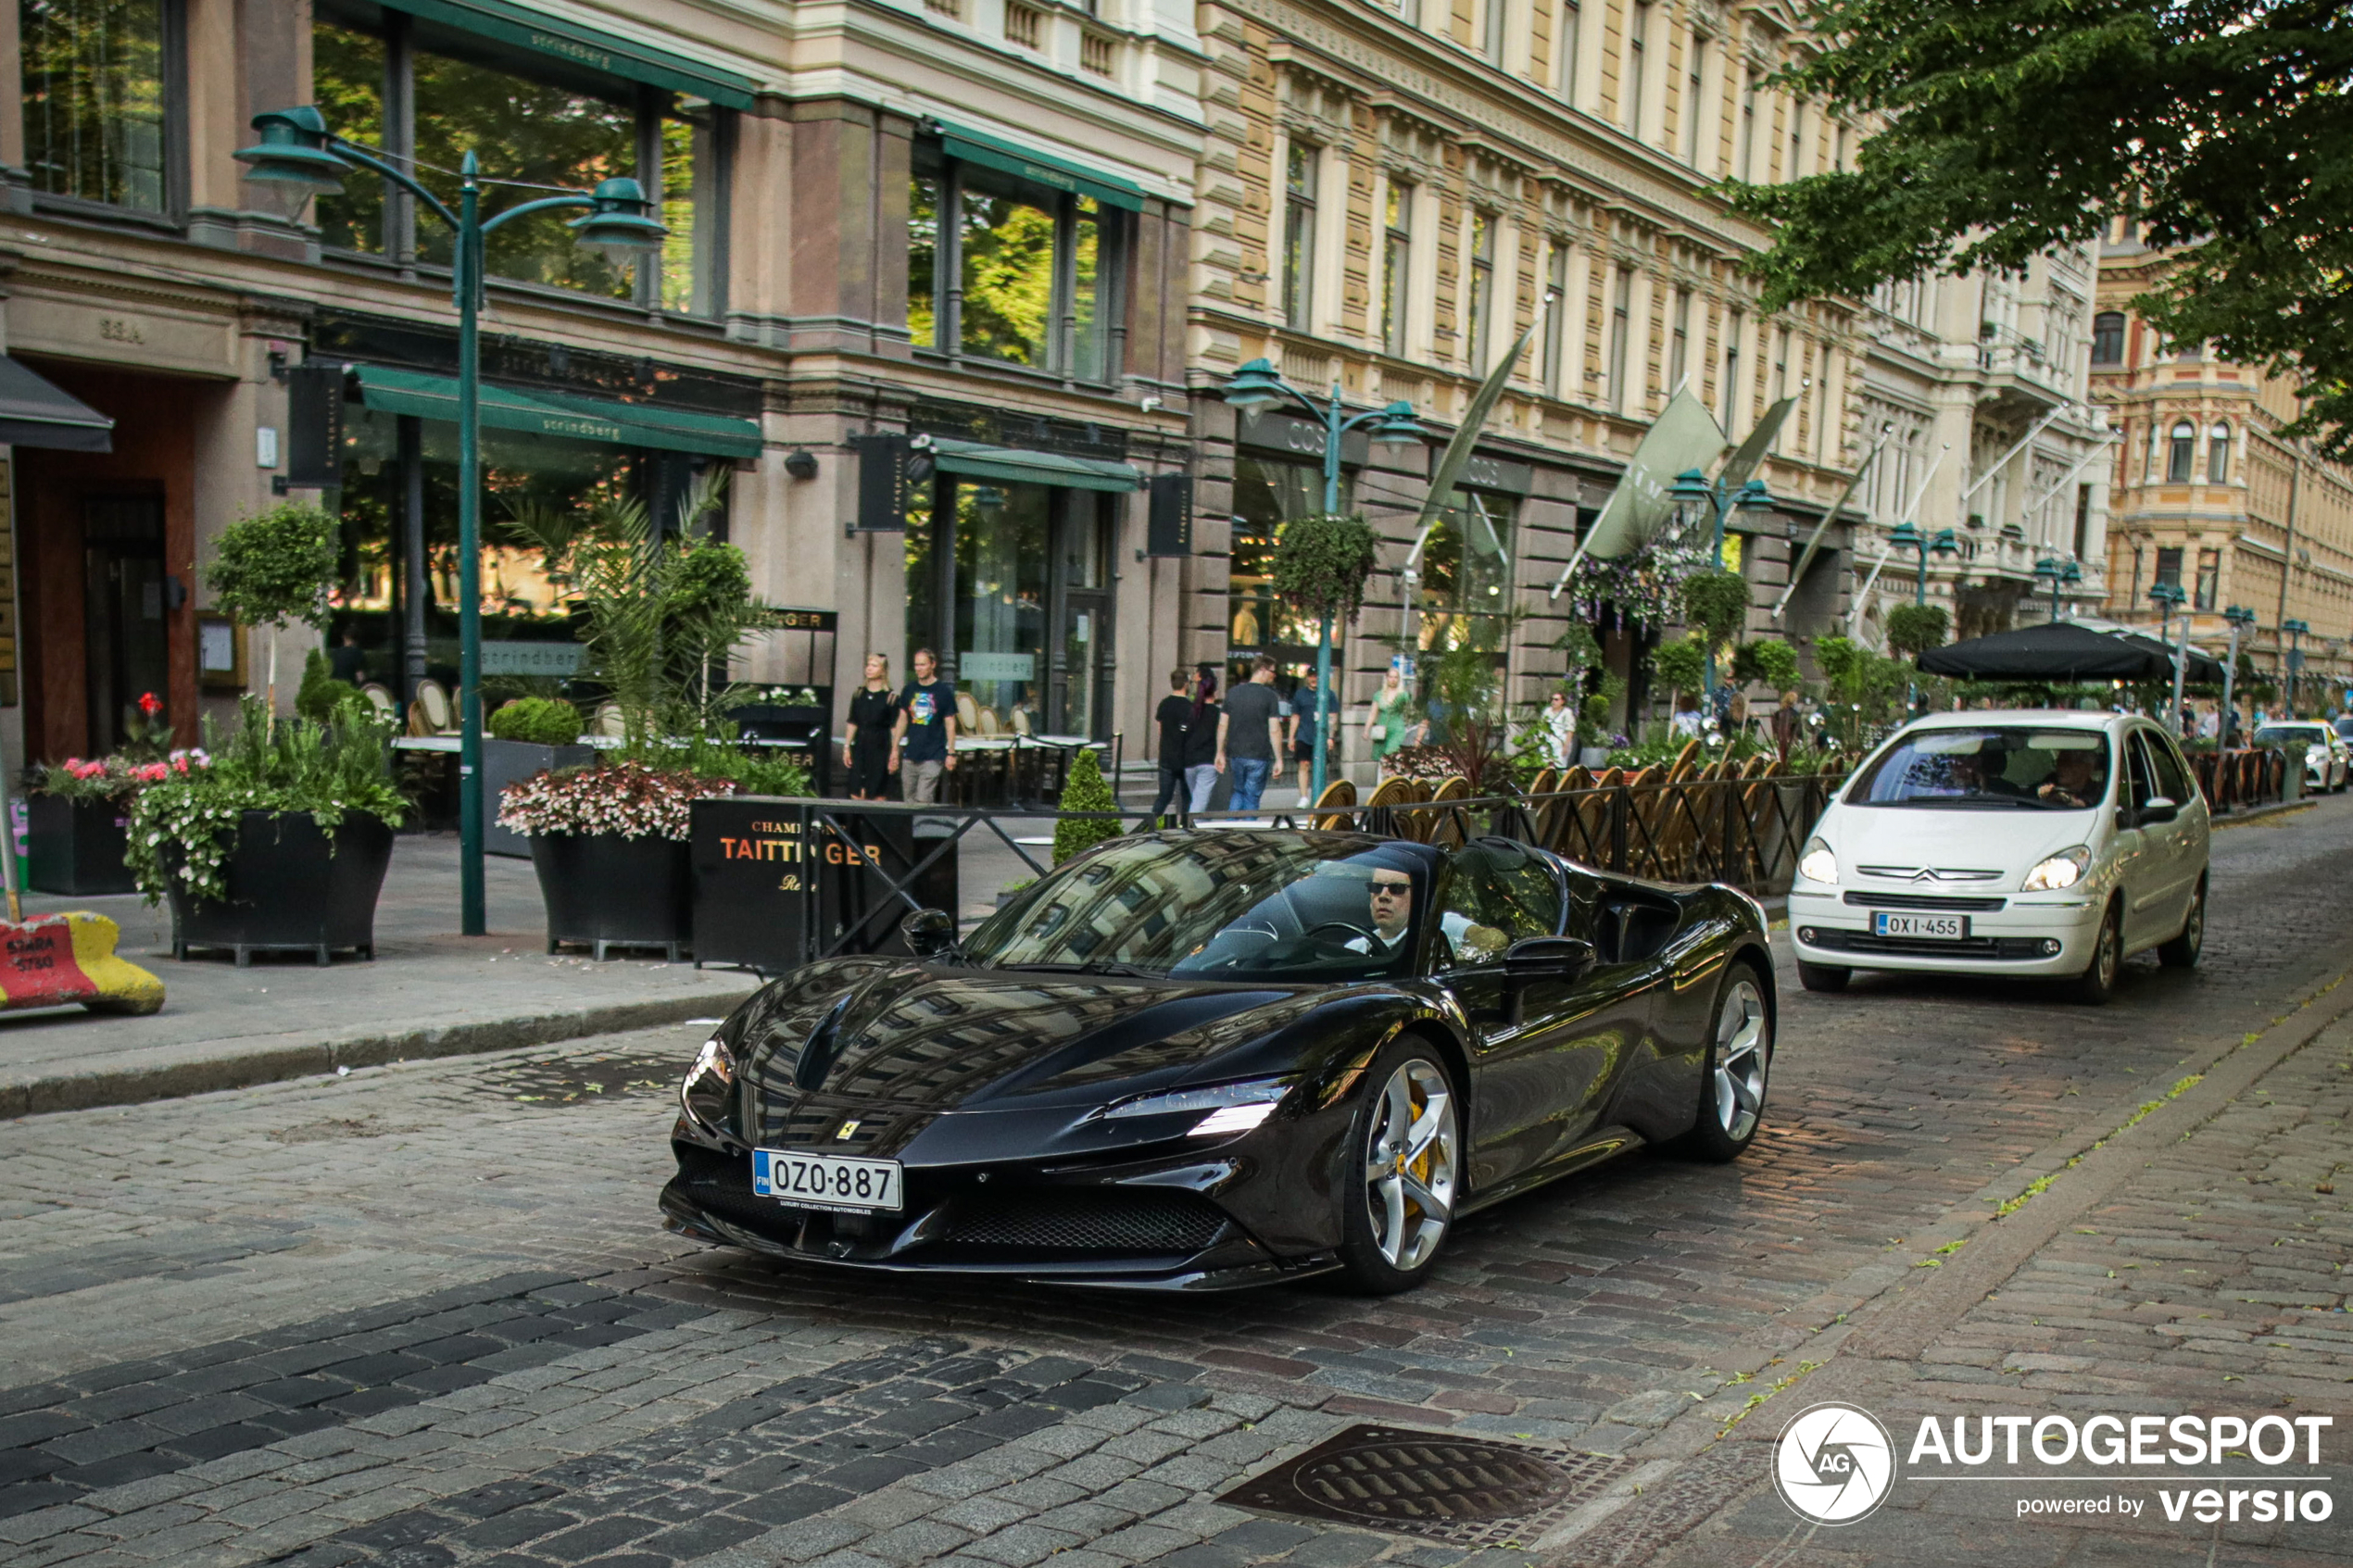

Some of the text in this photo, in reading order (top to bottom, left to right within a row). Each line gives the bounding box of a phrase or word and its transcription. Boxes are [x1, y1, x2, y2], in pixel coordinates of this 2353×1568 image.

[543, 419, 621, 441] strindberg
[1289, 421, 1326, 455] COS
[1469, 458, 1498, 486] COS
[720, 837, 881, 867] TAITTIGER
[1890, 918, 1957, 935] OXI-455
[757, 1176, 770, 1187] FIN
[775, 1160, 891, 1200] OZO-887
[780, 1200, 872, 1215] LUXURY COLLECTION AUTOMOBILES
